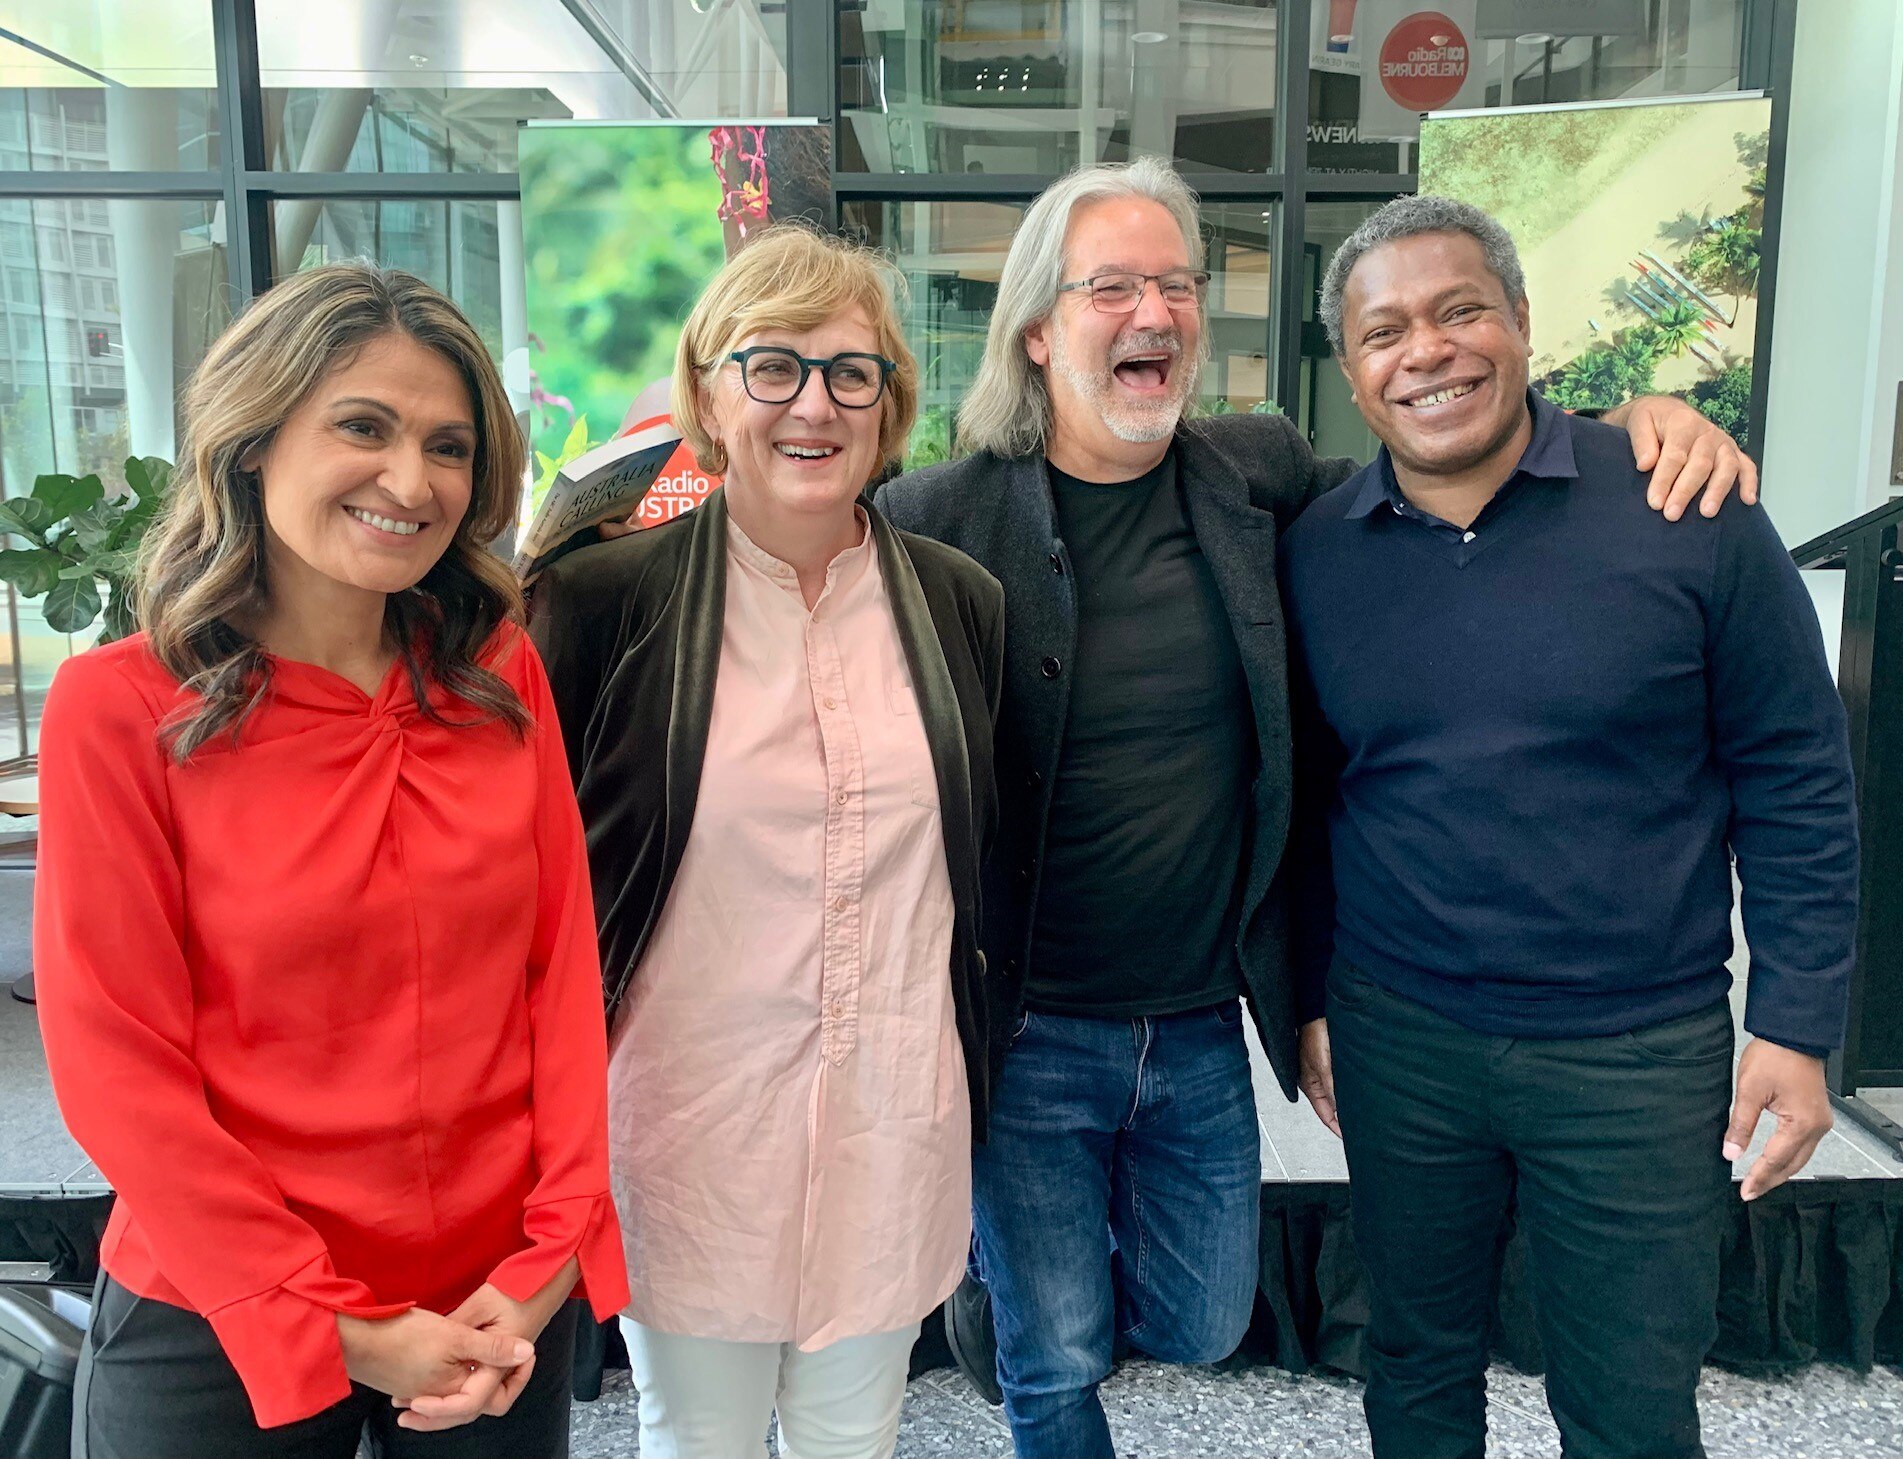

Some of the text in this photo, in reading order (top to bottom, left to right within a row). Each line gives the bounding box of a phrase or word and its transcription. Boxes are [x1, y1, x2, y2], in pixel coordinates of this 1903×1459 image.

[567, 462, 655, 512] AUSTRALIA
[651, 470, 709, 494] adio
[559, 483, 629, 527] CALLING
